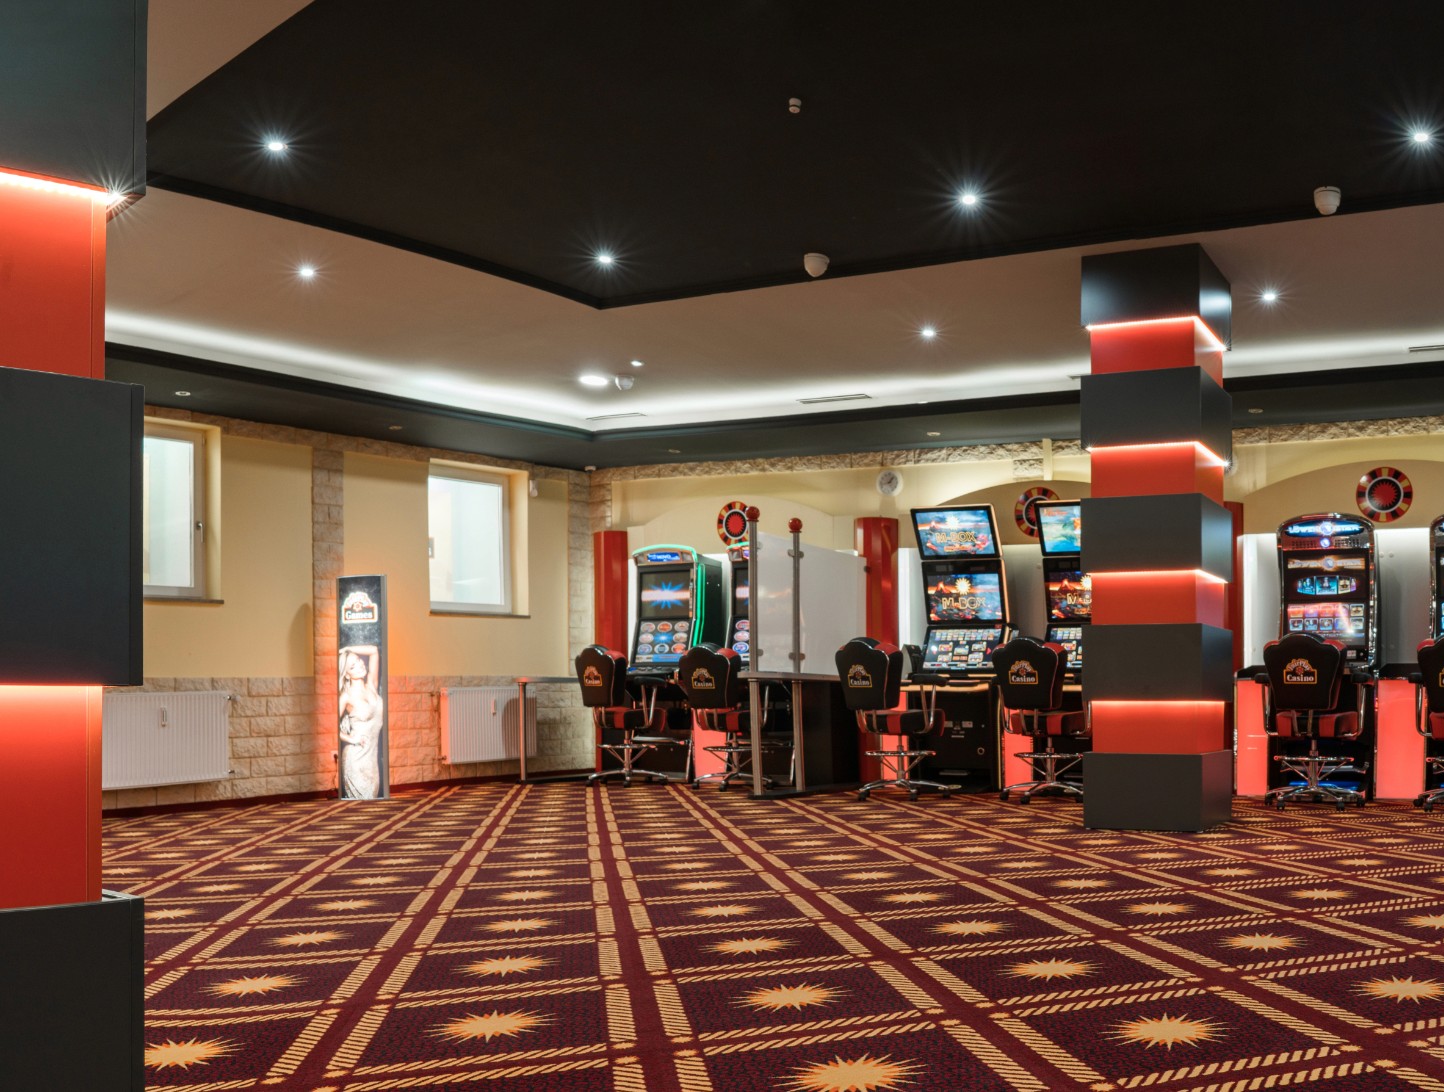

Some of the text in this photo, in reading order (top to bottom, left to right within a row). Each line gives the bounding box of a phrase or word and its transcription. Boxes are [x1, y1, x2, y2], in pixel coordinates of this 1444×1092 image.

[942, 597, 987, 610] M-BOX
[1011, 675, 1036, 683] Casino
[1286, 673, 1314, 682] Casino
